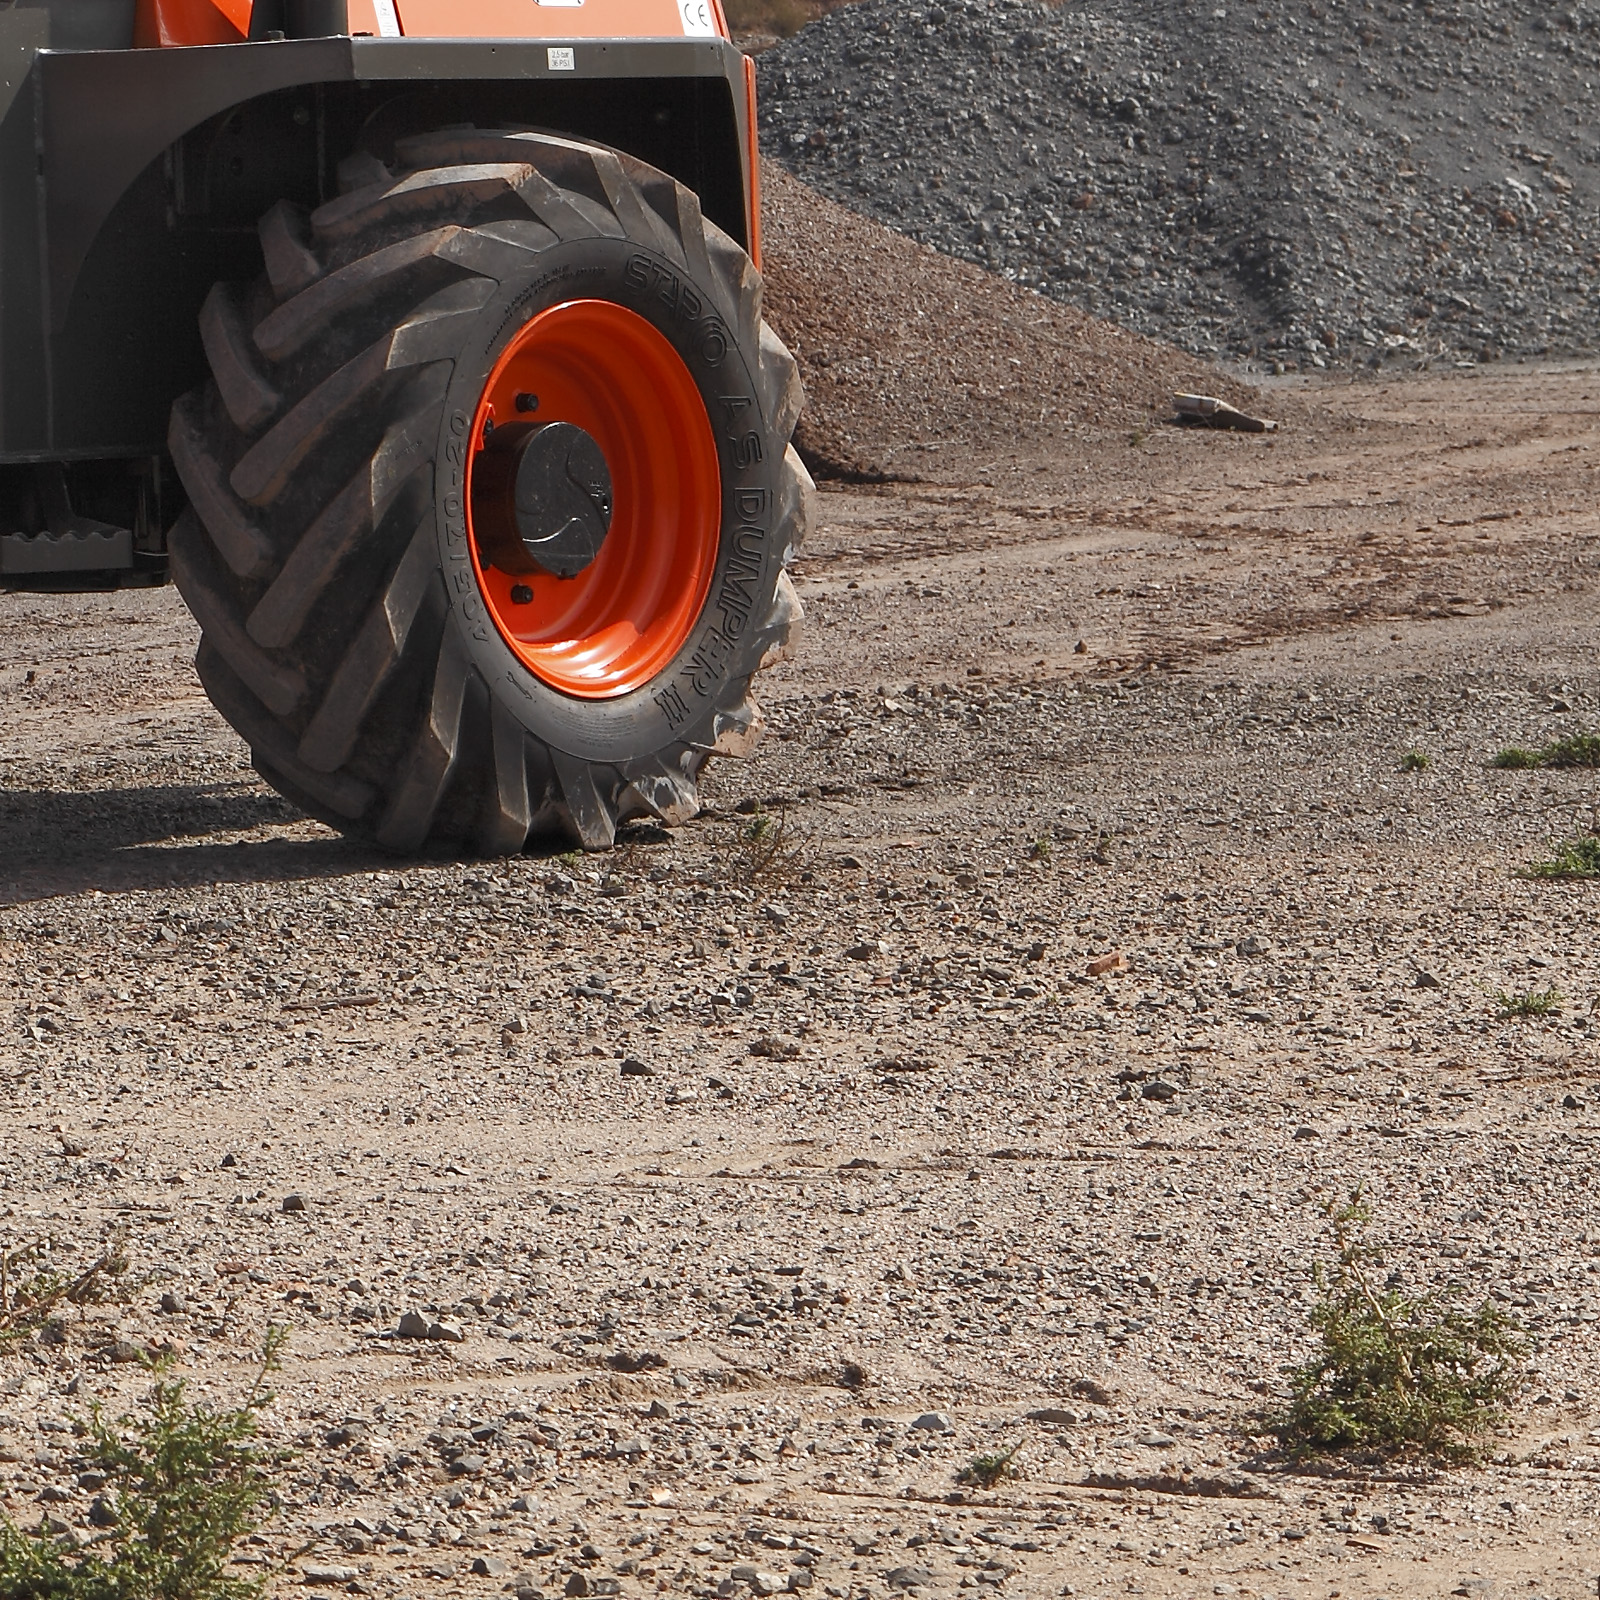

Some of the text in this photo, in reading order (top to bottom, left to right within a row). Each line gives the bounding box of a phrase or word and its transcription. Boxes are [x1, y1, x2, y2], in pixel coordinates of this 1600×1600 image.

[684, 3, 708, 27] CE
[719, 396, 763, 471] AS
[680, 487, 766, 698] DUMPER
